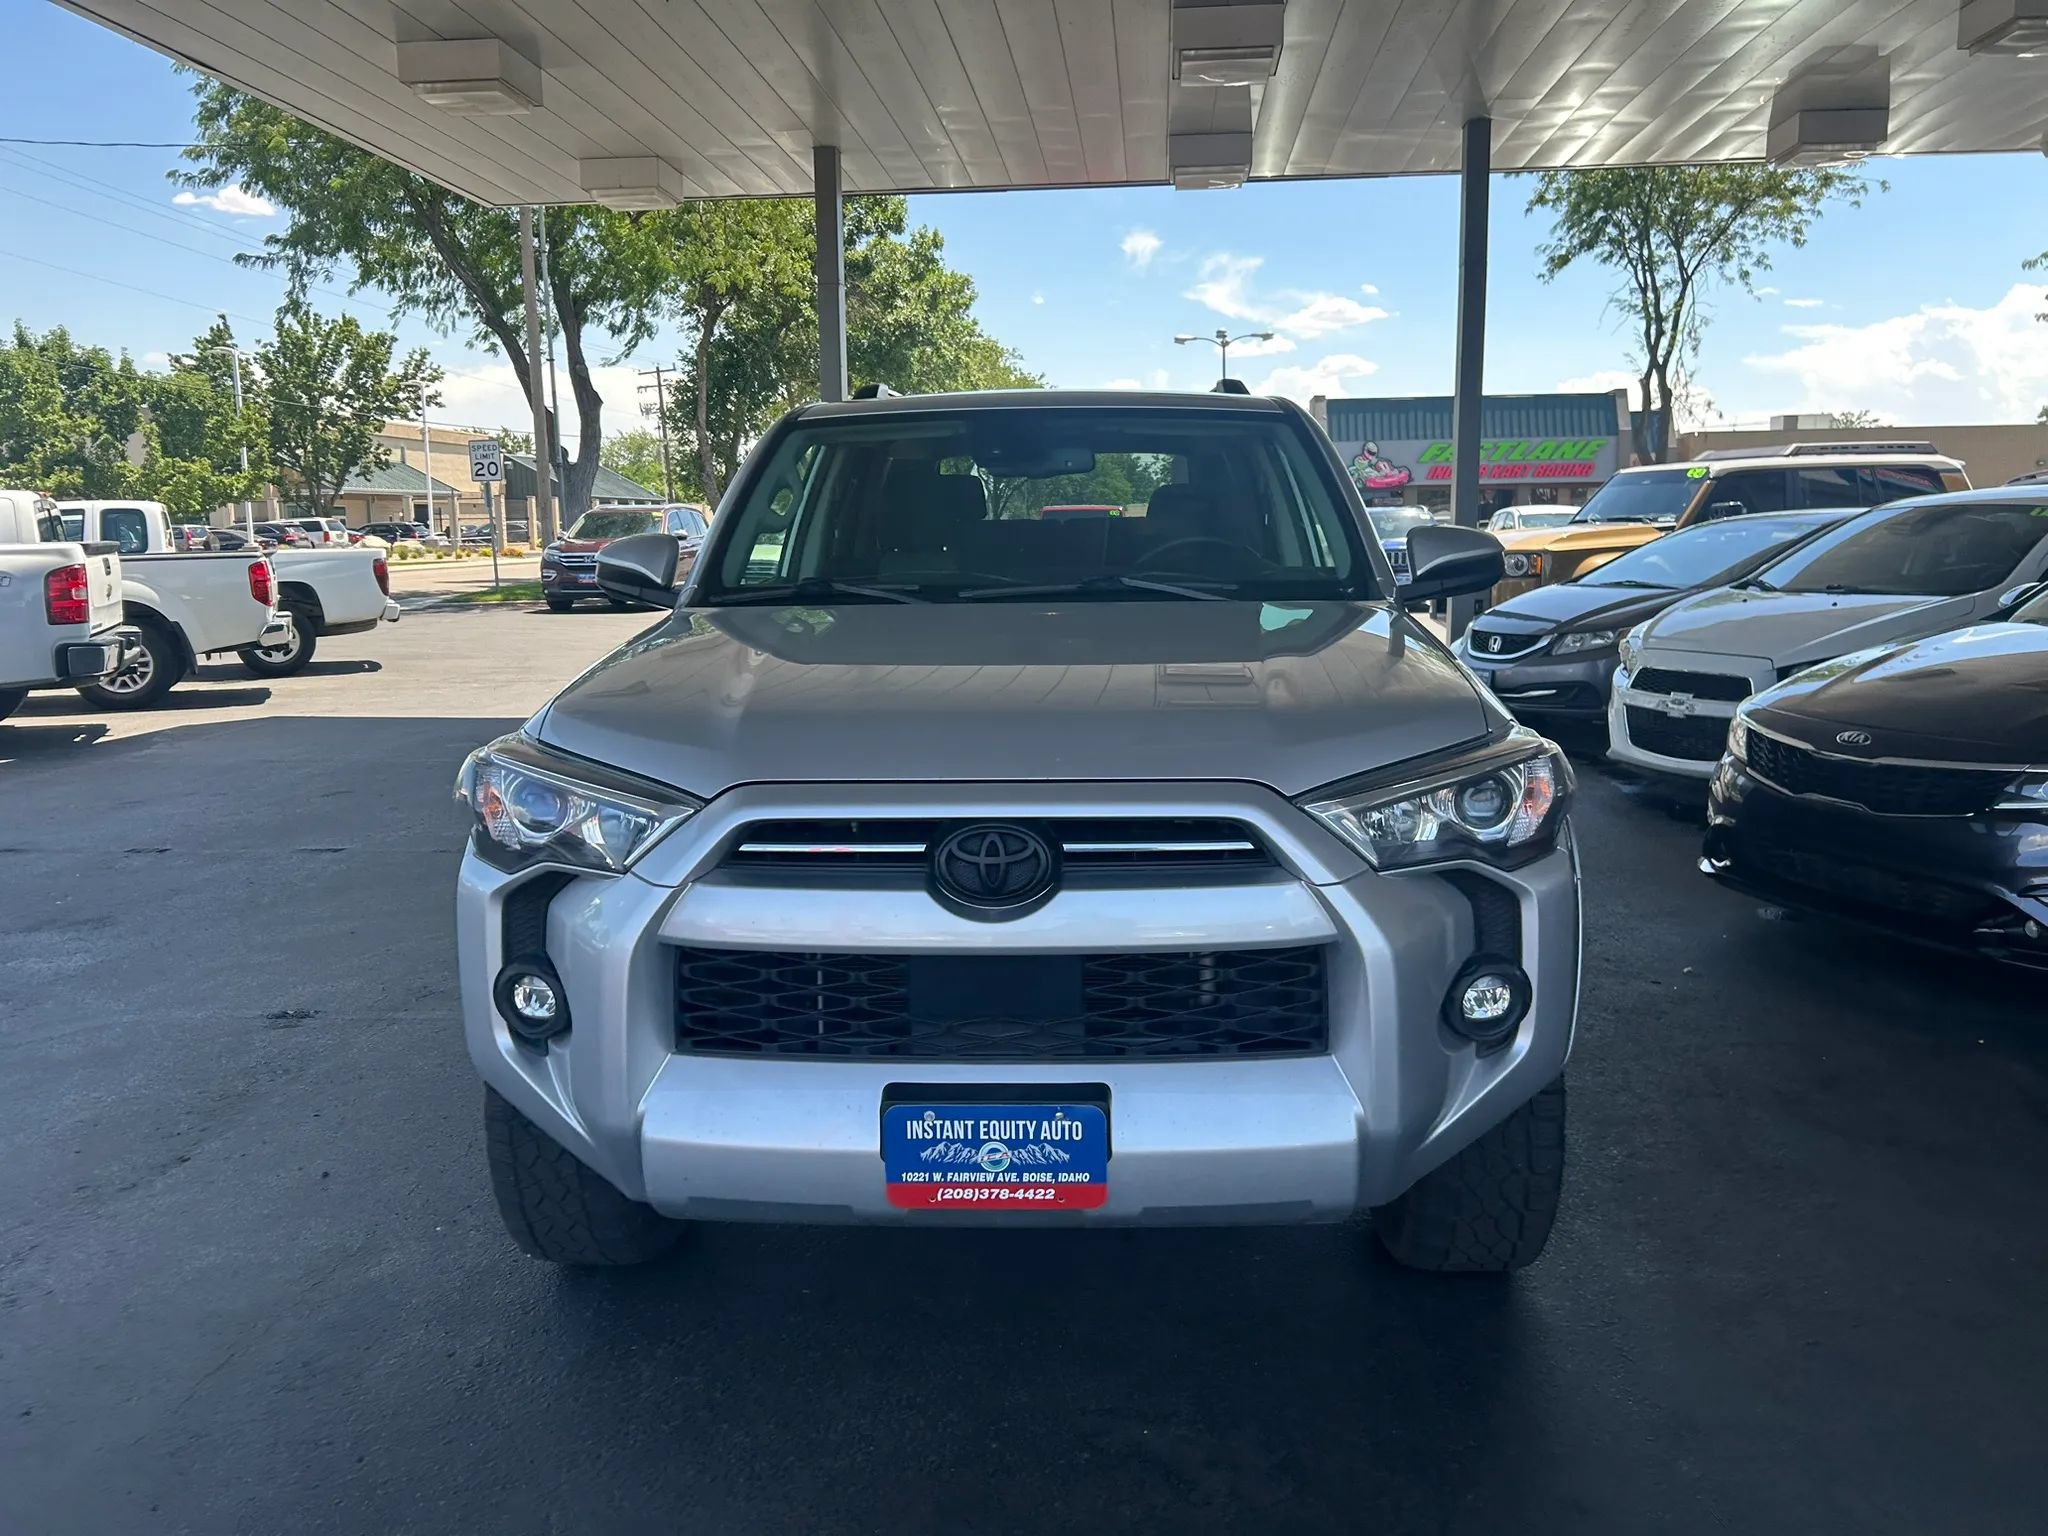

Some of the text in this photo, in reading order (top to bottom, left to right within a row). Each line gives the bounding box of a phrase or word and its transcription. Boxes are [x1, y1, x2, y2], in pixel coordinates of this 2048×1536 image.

[471, 444, 497, 452] SPEED
[474, 462, 498, 476] 20
[1491, 463, 1533, 479] KART
[1533, 462, 1596, 479] RACING
[1840, 731, 1865, 743] KIA
[906, 1120, 1083, 1141] INSTANT EQUITY AUTO
[901, 1172, 1091, 1184] 10221 W. FAIRVIEW AVE. BOISE, IDAHO
[937, 1188, 1055, 1201] (208)378-4422
